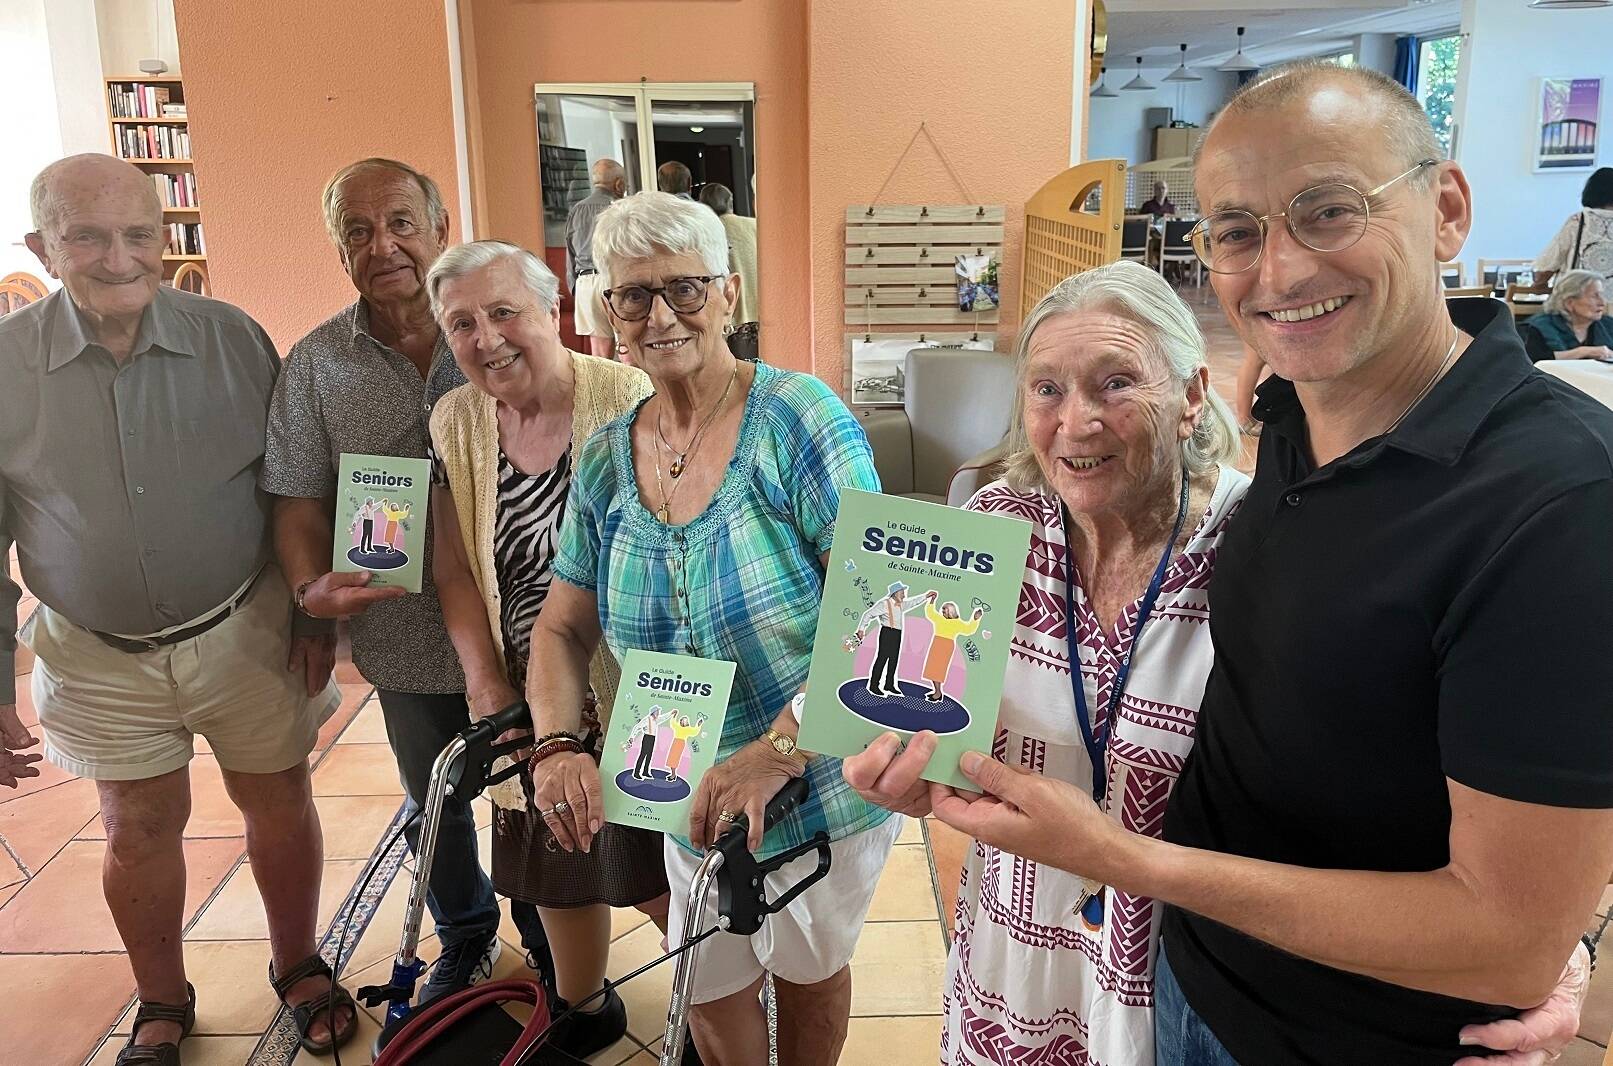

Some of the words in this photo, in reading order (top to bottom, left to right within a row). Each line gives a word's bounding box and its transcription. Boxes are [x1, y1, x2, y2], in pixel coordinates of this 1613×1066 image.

[351, 470, 413, 488] Seniors
[887, 520, 898, 530] Le
[899, 523, 926, 535] Guide
[862, 526, 994, 574] Seniors
[887, 561, 898, 570] de
[899, 562, 962, 582] Sainte-Maxime
[658, 668, 675, 676] Guide
[637, 671, 712, 697] Seniors
